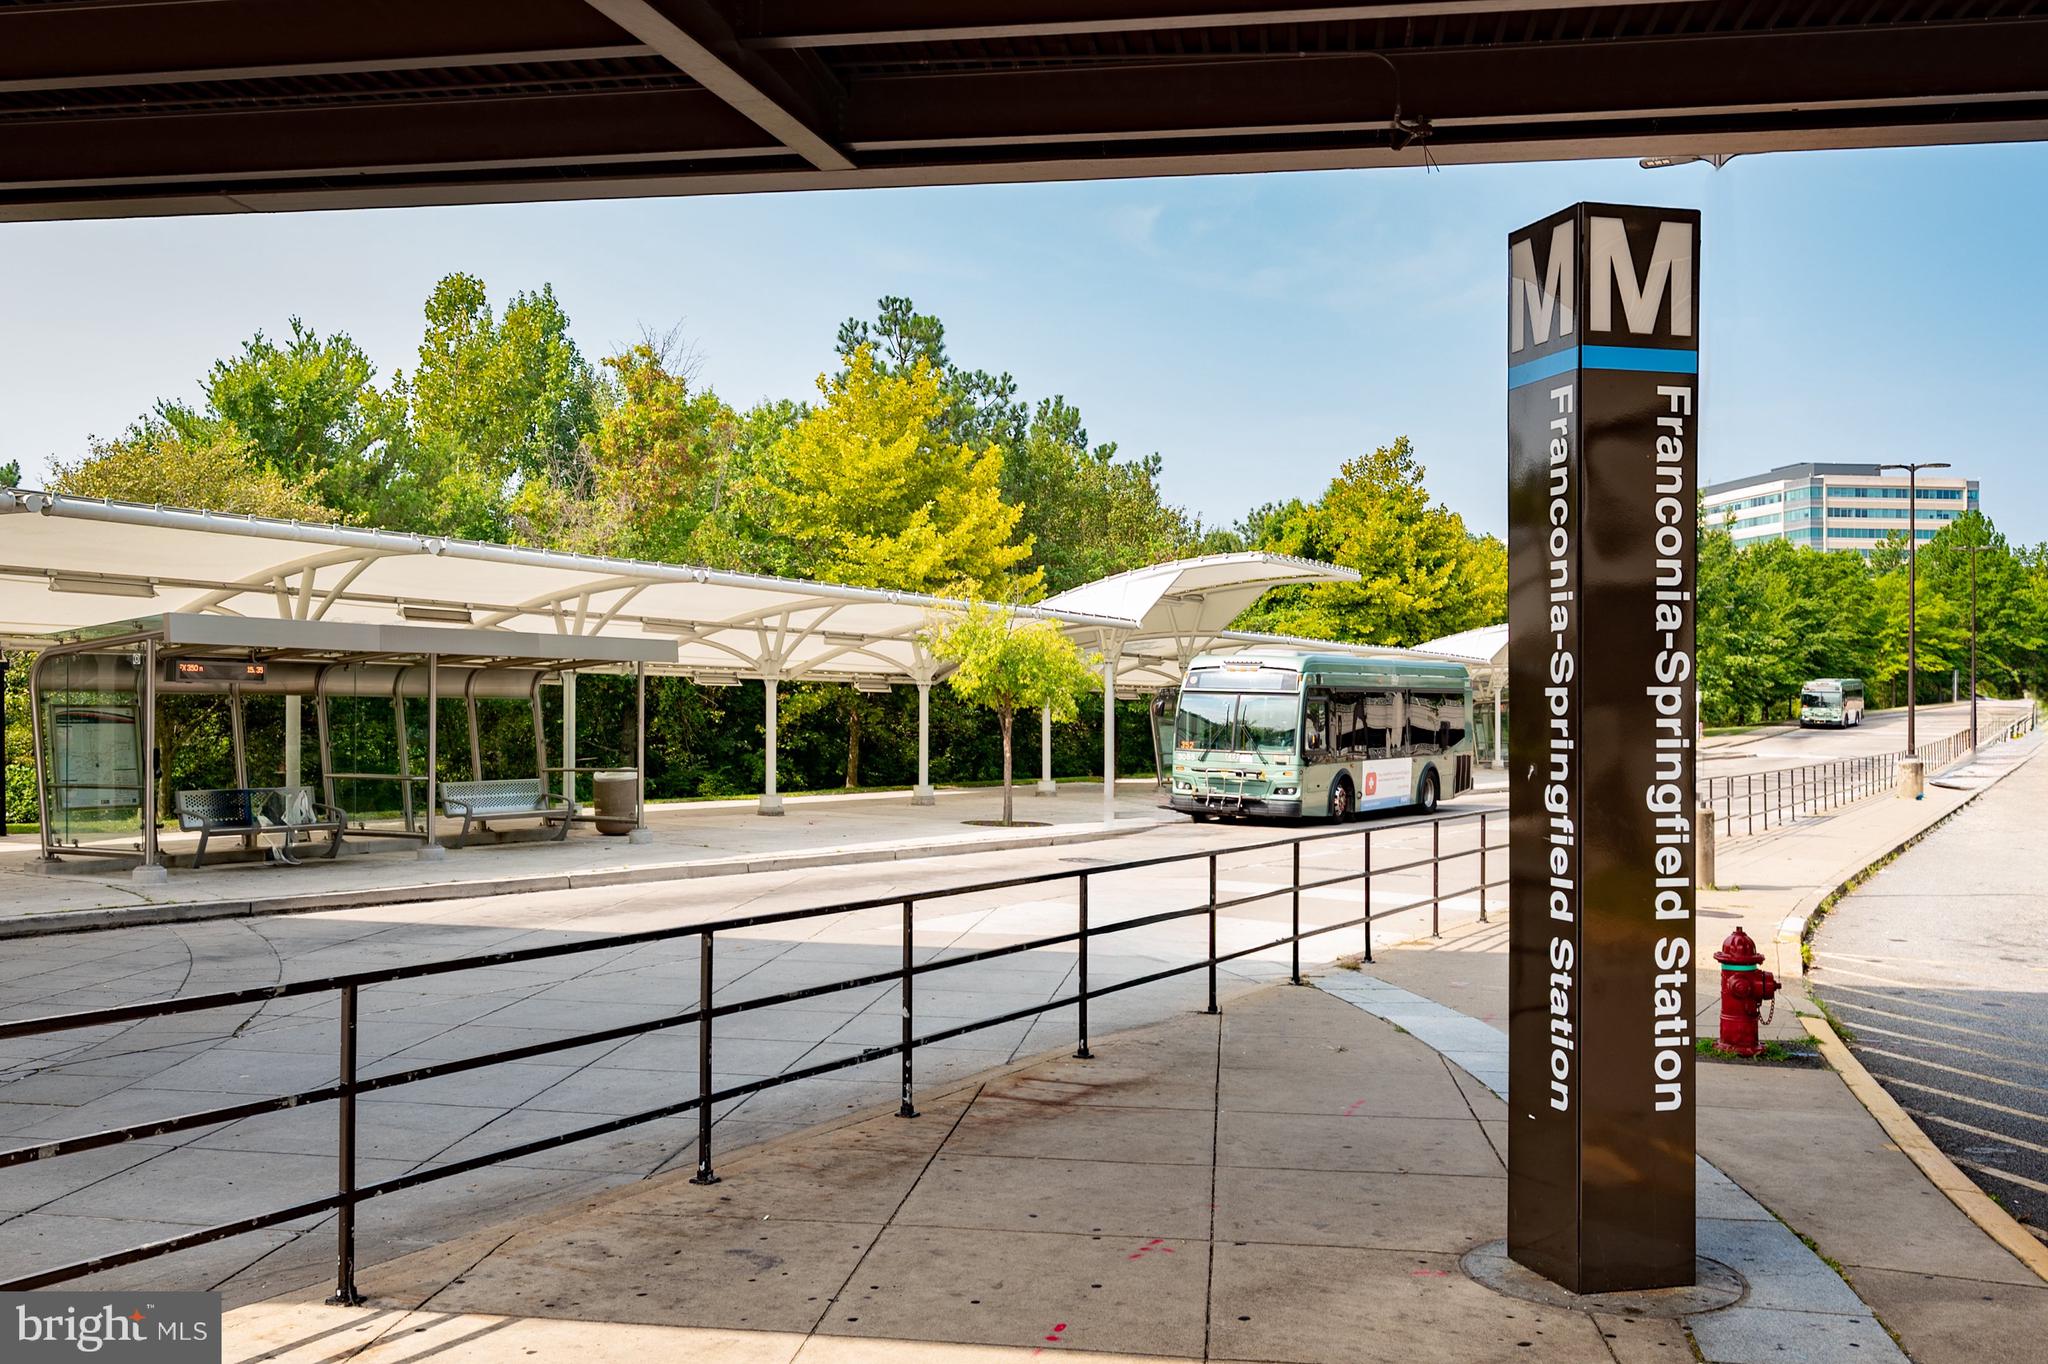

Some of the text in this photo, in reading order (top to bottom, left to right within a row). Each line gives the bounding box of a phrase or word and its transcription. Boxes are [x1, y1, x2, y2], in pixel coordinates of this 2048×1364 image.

[1511, 219, 1575, 354] M
[1589, 216, 1693, 337] M
[1544, 384, 1575, 1112] Franconia-Springfield Station
[1646, 384, 1692, 1112] Franconia-Springfield Station
